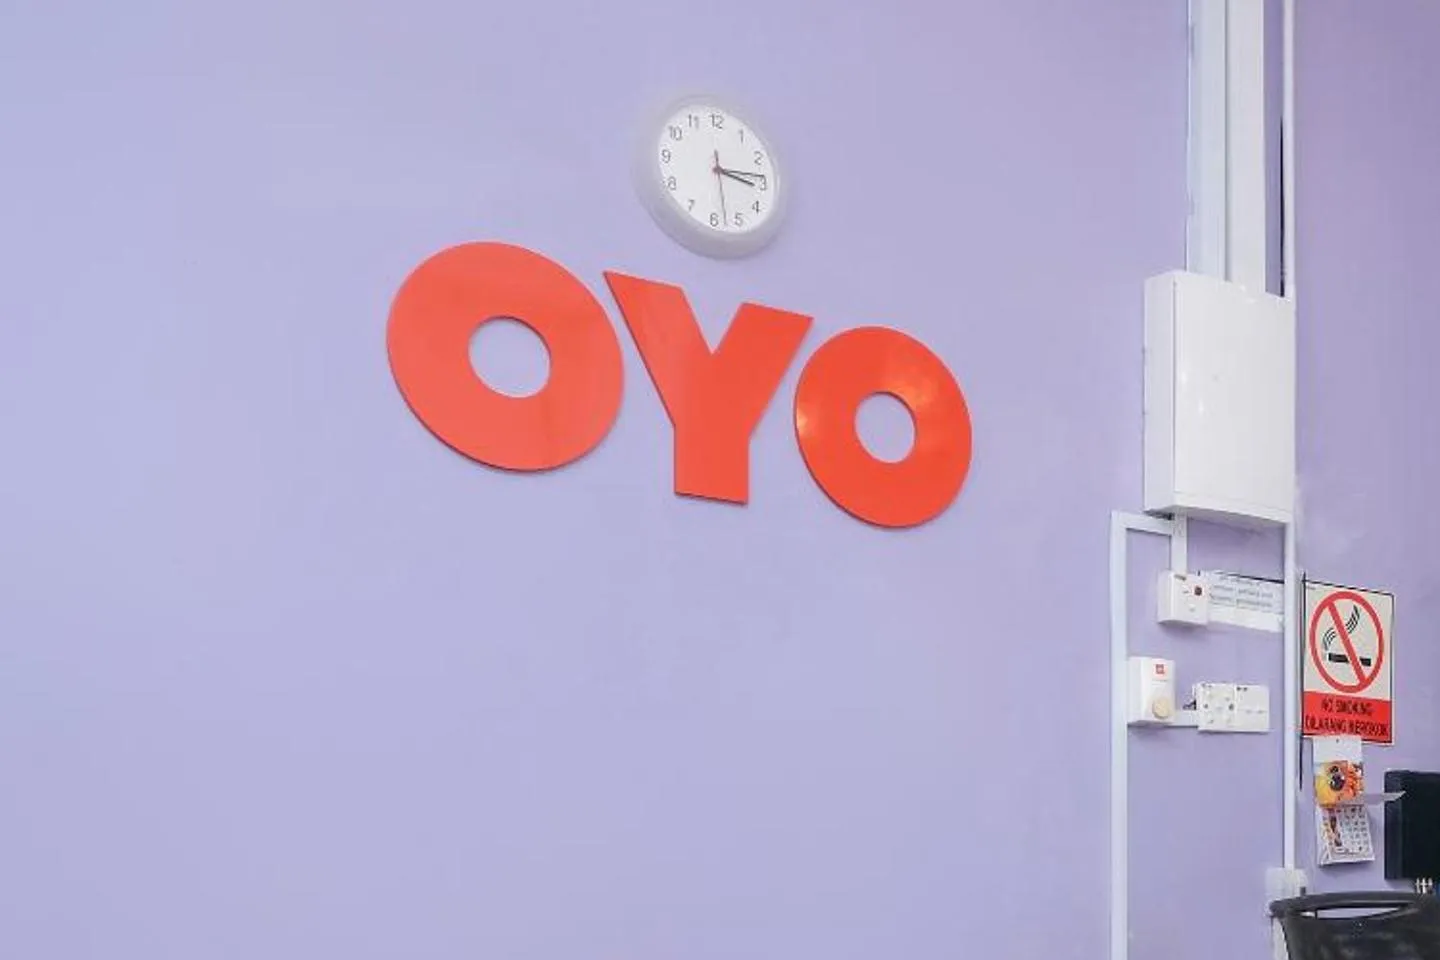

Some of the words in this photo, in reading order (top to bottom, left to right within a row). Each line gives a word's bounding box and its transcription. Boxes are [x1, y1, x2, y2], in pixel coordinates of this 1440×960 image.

[687, 113, 699, 129] 11
[710, 113, 724, 129] 12
[668, 126, 683, 141] 10
[738, 129, 745, 143] 1
[661, 149, 671, 163] 9
[753, 150, 764, 165] 2
[666, 176, 677, 191] 8
[759, 175, 768, 191] 3
[687, 199, 695, 211] 7
[752, 200, 761, 214] 4
[709, 212, 719, 227] 6
[734, 212, 744, 226] 5
[386, 241, 972, 529] OYO
